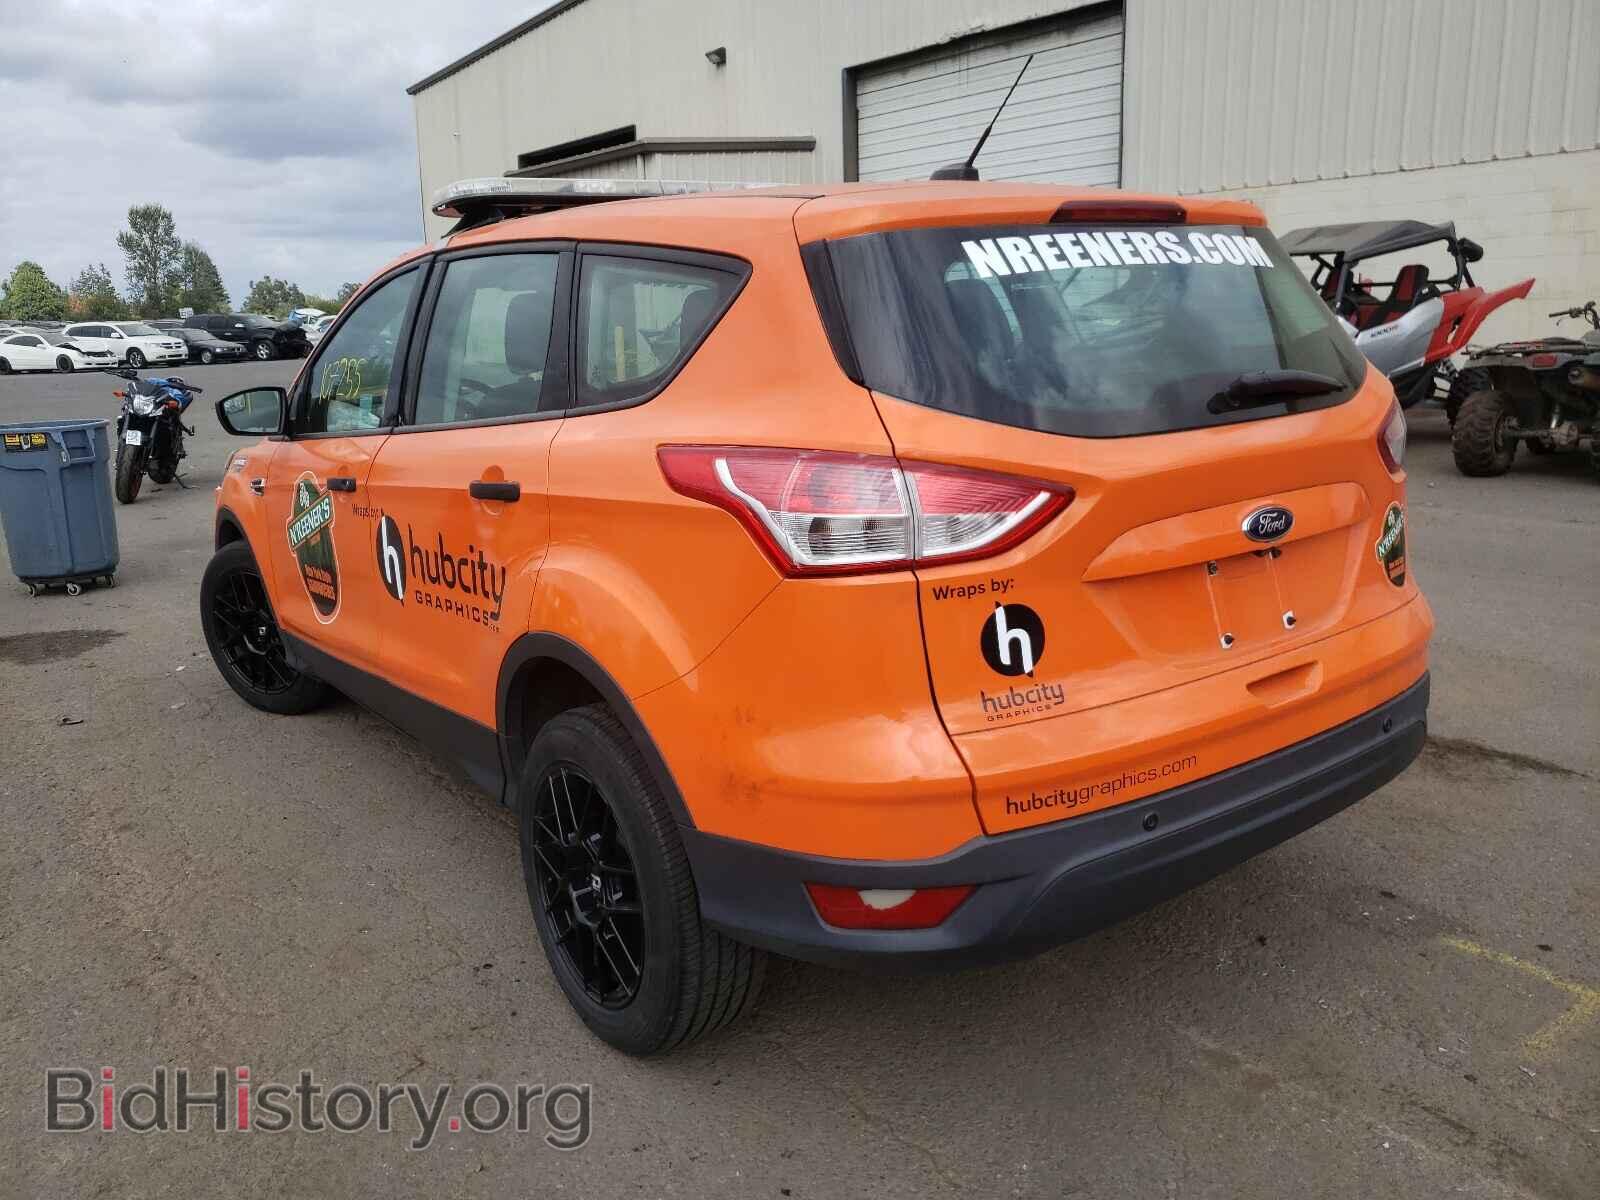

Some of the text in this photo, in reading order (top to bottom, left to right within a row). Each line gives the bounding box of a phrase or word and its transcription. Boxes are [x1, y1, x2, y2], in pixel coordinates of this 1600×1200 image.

[961, 231, 1275, 278] NREENERS.COM
[1258, 511, 1286, 535] Ford
[408, 522, 507, 622] hubcity
[932, 578, 1015, 600] Wraps by:
[415, 589, 490, 627] GRAPHICS
[980, 683, 1065, 713] hubcity
[986, 703, 1053, 722] GRAPHICS
[1005, 754, 1199, 815] hubcitygraphics.com
